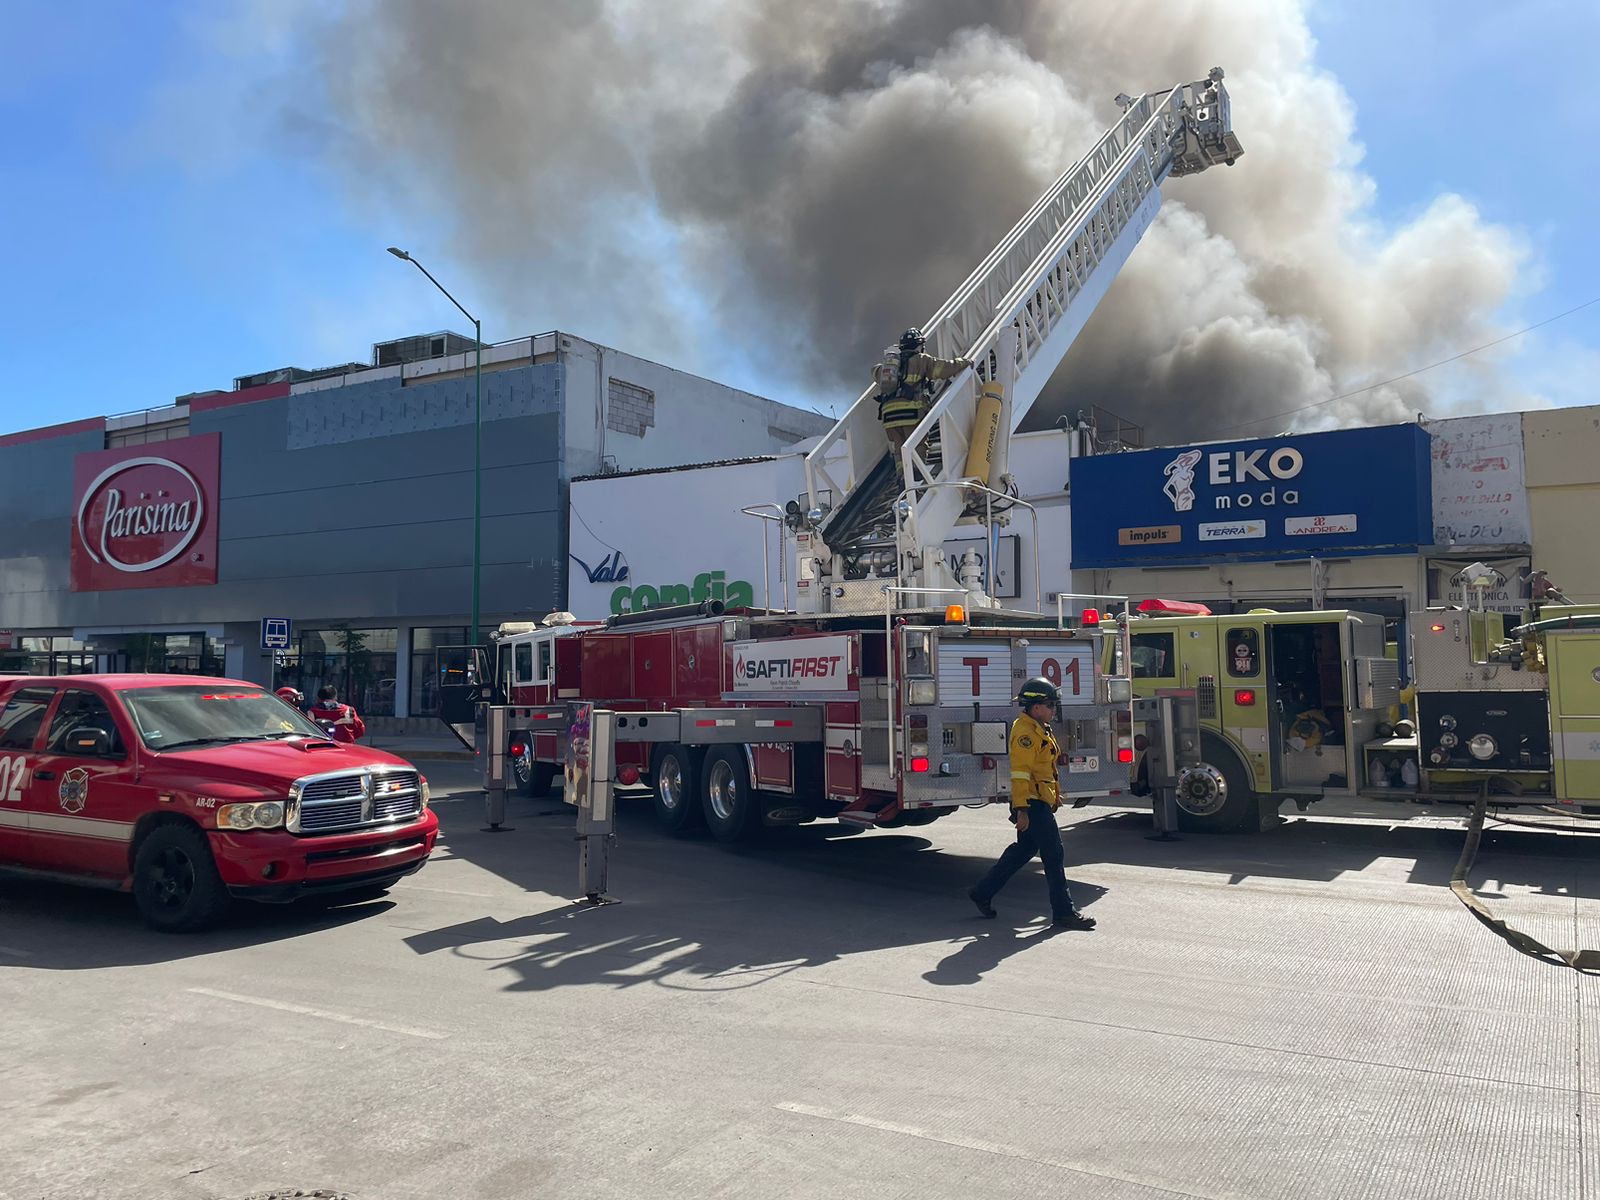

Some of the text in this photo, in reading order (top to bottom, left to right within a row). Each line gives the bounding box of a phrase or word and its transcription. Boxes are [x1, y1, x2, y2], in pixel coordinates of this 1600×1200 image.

[1209, 447, 1303, 485] EKO
[1215, 486, 1299, 509] moda
[102, 488, 191, 538] Parisina
[1130, 530, 1168, 542] impuls
[1206, 527, 1246, 537] TERRA
[1294, 526, 1347, 535] ANDREA
[569, 551, 629, 583] Vale
[610, 570, 753, 614] confia
[746, 656, 841, 679] SAFTIFIRST
[963, 657, 1080, 696] T 91
[196, 797, 215, 808] AR-02
